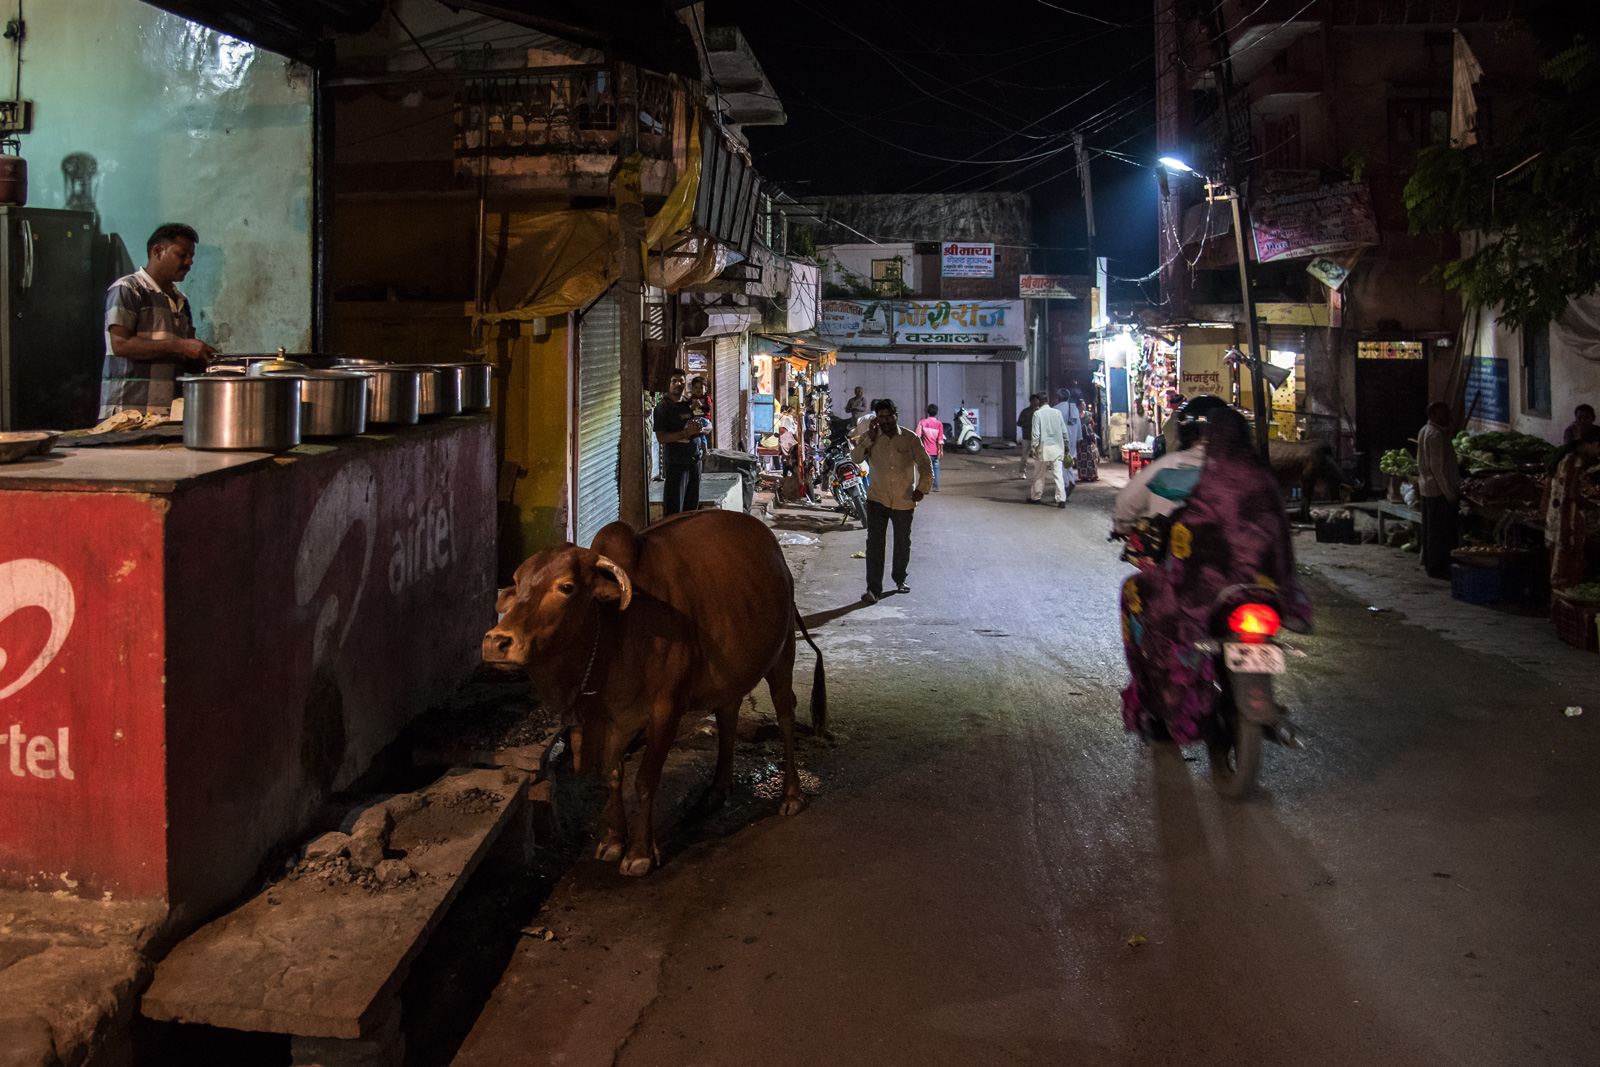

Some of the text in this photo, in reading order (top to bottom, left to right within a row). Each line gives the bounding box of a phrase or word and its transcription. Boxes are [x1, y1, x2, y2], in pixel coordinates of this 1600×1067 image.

[905, 333, 989, 343] वस्त्रालय
[386, 490, 457, 596] airtel
[0, 724, 75, 780] tel
